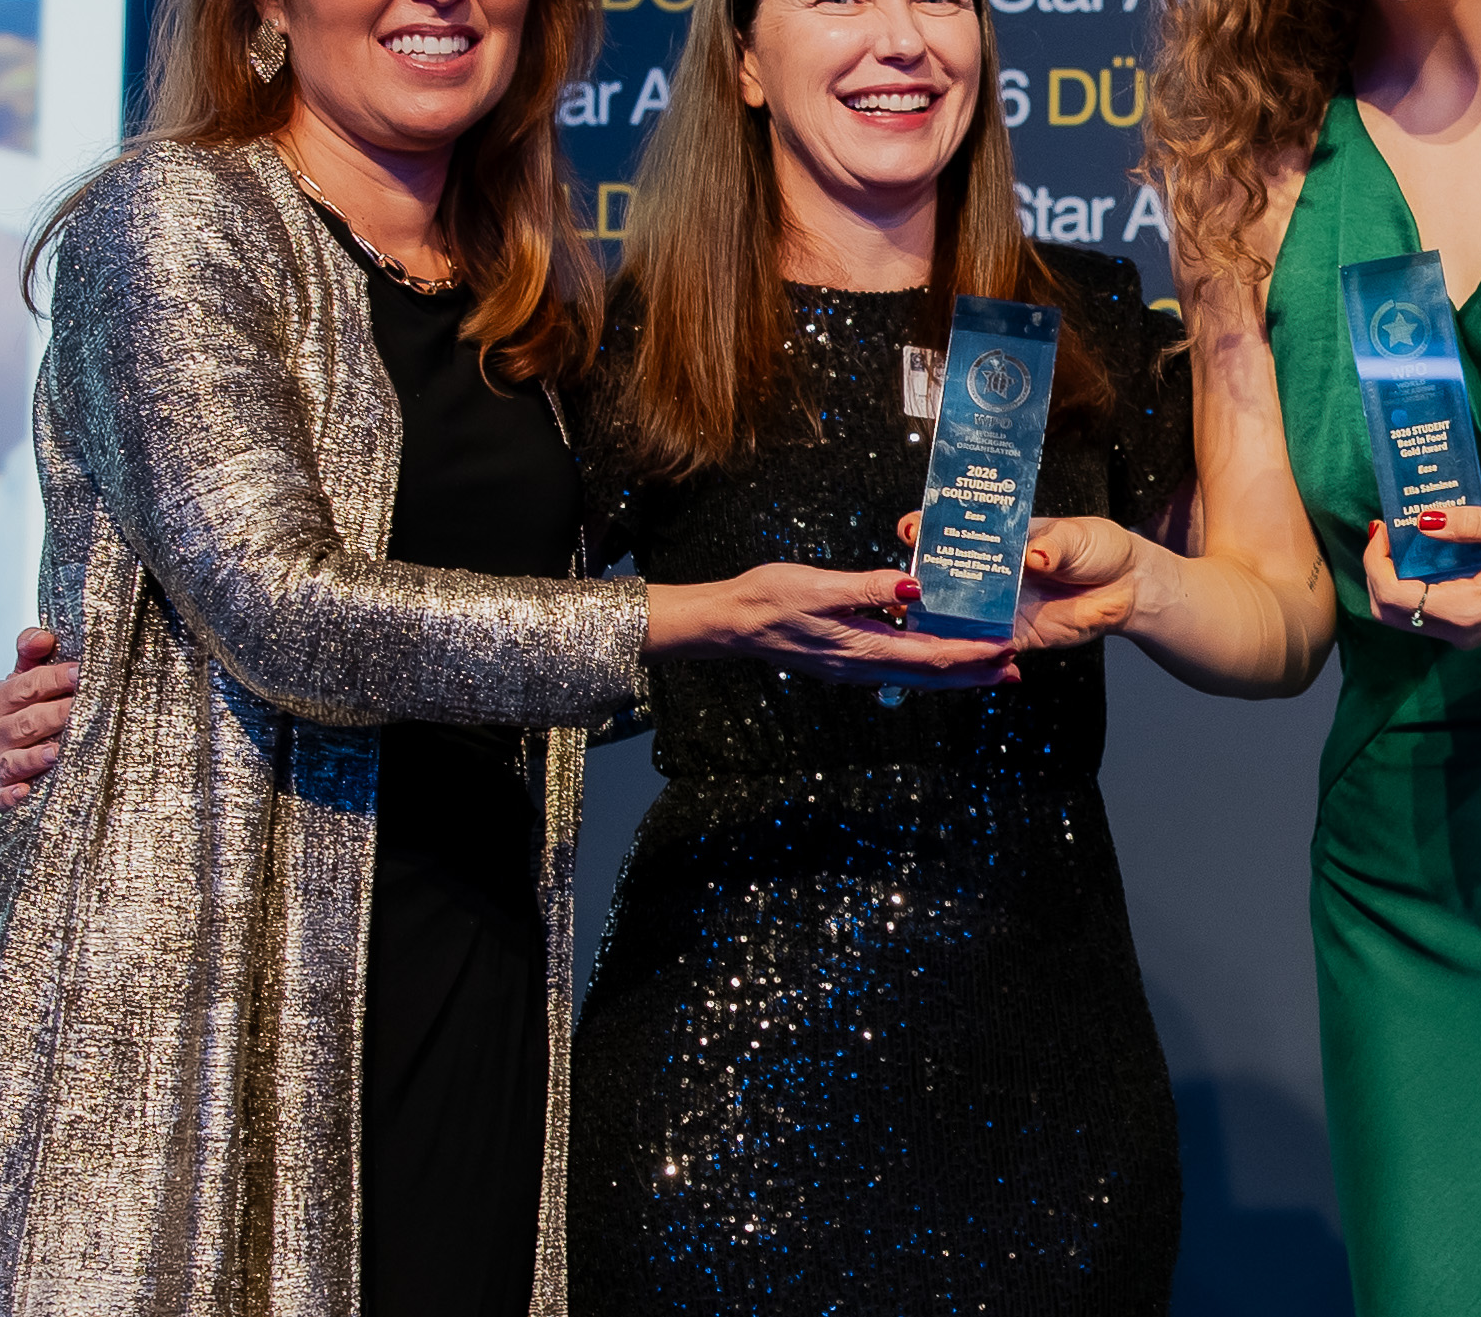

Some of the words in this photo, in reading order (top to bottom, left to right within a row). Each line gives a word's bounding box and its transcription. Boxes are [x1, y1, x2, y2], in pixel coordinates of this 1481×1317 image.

[1390, 427, 1411, 440] 2026
[1412, 420, 1450, 434] STUDENT
[1426, 432, 1447, 443] Food
[1400, 446, 1421, 458] Gold
[1422, 442, 1448, 455] Award
[966, 465, 997, 480] 2026
[956, 477, 1003, 493] STUDENT
[941, 487, 972, 501] GOLD
[973, 491, 1016, 506] TROPHY
[1394, 516, 1418, 528] Desig
[992, 553, 1003, 562] of
